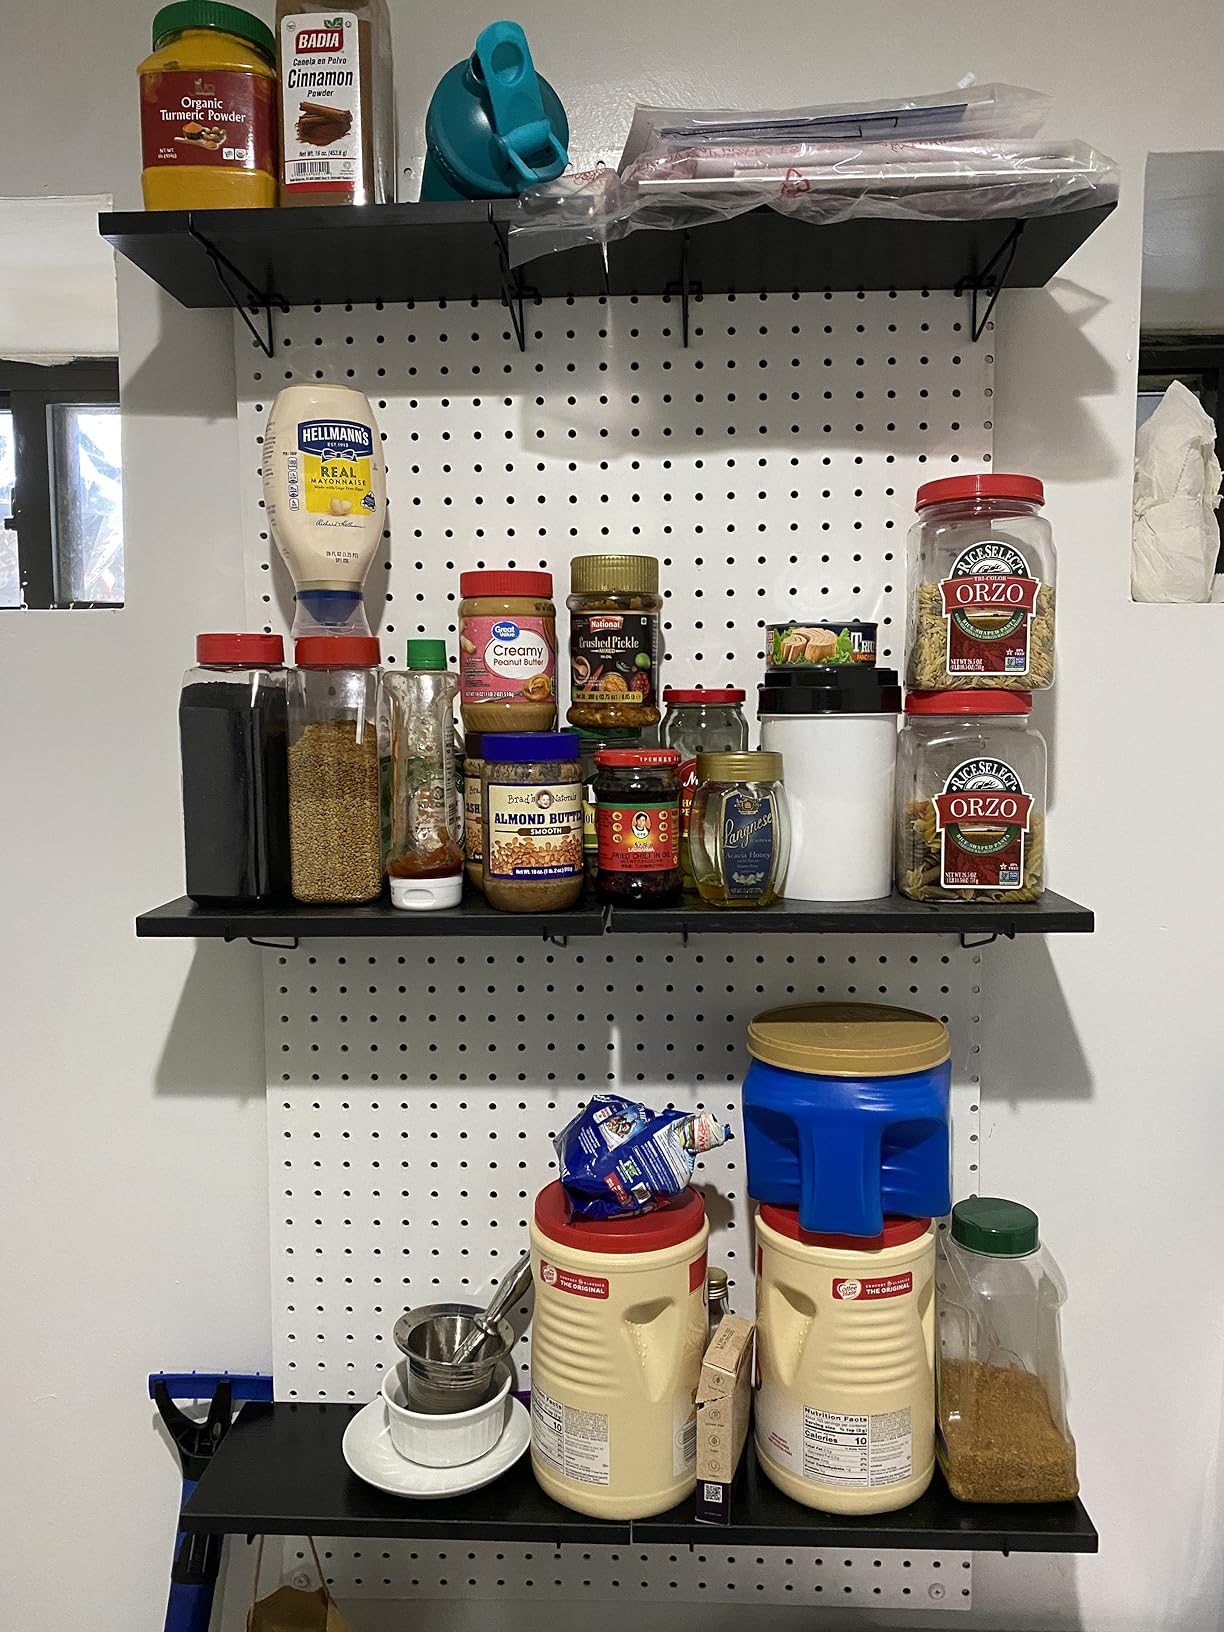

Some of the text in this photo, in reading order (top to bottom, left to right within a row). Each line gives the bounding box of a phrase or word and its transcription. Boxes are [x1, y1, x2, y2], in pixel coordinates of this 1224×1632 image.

[298, 32, 340, 49] BADIA
[293, 58, 315, 66] Canela
[328, 56, 347, 65] Polvo
[288, 69, 353, 89] Cinnamon
[307, 89, 334, 98] Powder
[181, 97, 223, 110] Organic
[160, 110, 246, 123] Turmeric Powder
[303, 426, 369, 445] HELLMANN'S
[321, 466, 357, 478] REAL
[957, 544, 1024, 573] RICESELECT
[956, 583, 1024, 603] ORZO
[1000, 618, 1016, 632] PASTA
[579, 636, 639, 648] Crushed Pickle
[493, 645, 544, 658] Creamy
[951, 761, 1018, 790] RICESELECT
[508, 794, 535, 804] Brad's
[950, 798, 1017, 818] ORZO
[495, 813, 545, 824] ALMOND
[723, 813, 772, 848] Langnese
[956, 834, 1010, 850] RICE-SHAPED PASTA
[750, 851, 770, 859] Honey
[560, 1280, 605, 1294] THE ORIGINAL
[882, 1283, 910, 1293] ORIGINAL
[805, 1407, 841, 1421] Nutrition
[554, 1422, 562, 1432] 10
[805, 1419, 824, 1428] Serving
[805, 1430, 838, 1443] Calories
